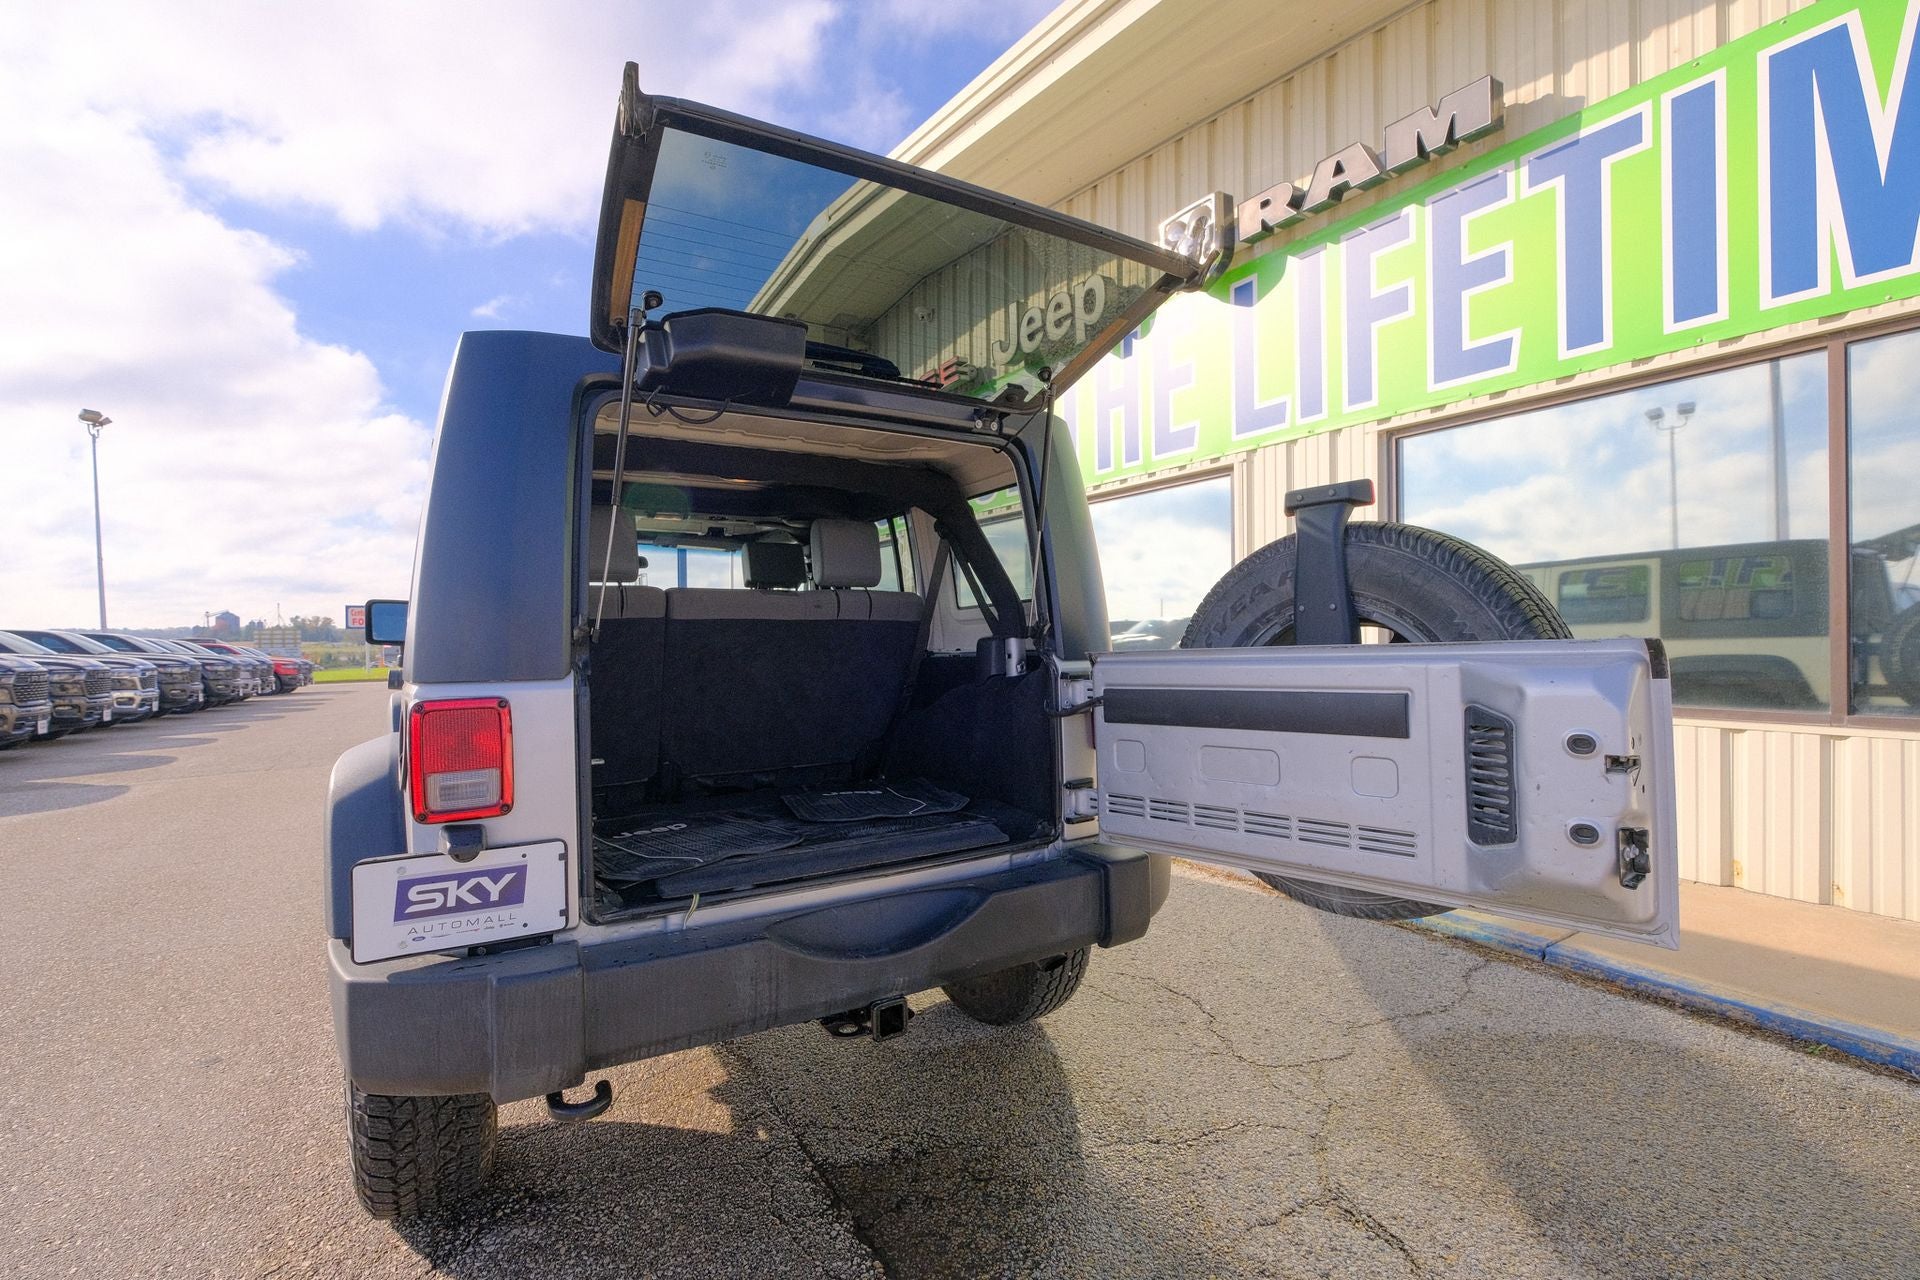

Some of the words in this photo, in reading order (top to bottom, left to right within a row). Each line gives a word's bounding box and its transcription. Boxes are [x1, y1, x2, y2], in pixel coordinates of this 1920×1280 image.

[1236, 74, 1499, 242] RAM
[991, 274, 1105, 366] Jeep
[403, 871, 518, 914] SKY
[407, 912, 518, 936] AUTOMALL
